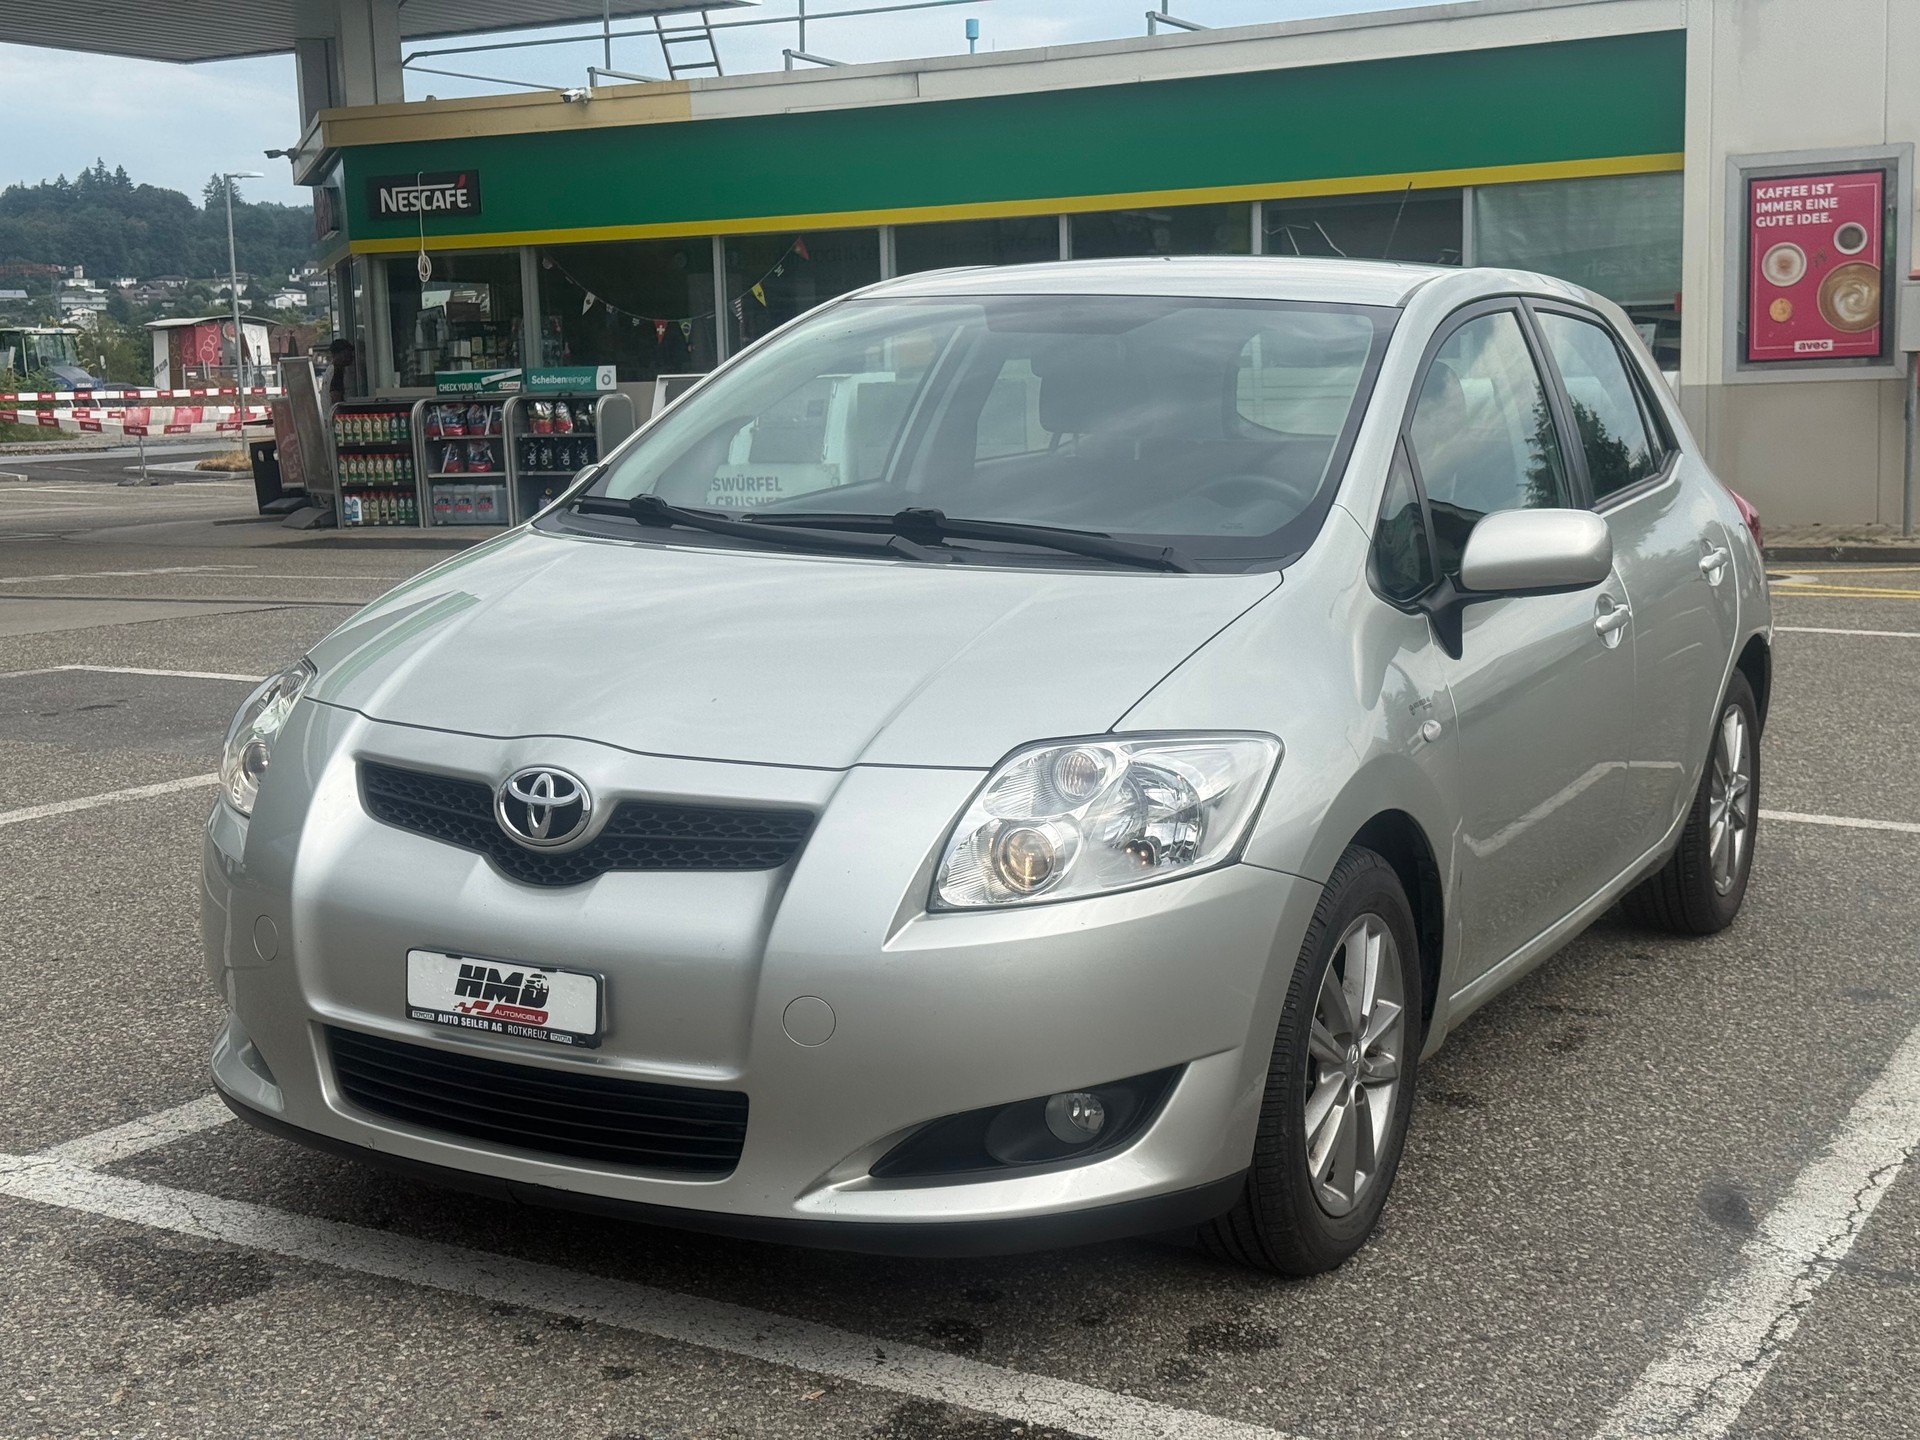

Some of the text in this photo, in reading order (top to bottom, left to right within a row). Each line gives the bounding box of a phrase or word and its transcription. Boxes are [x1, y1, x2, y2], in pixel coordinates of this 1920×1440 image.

[380, 174, 468, 213] NESCAFÉ
[1756, 183, 1834, 199] KAFFEE IST
[1756, 197, 1839, 214] IMMER EINE
[1755, 212, 1833, 228] GUTE IDEE.
[1798, 341, 1829, 351] avec
[439, 382, 483, 392] CHECK YOUR OIL
[531, 374, 591, 386] Scheibenreiniger
[494, 1009, 544, 1022] AUTOMOBILE
[437, 1014, 548, 1040] AUTO SEILER AG ROTKREUZ
[552, 1034, 571, 1042] TOYOTA
